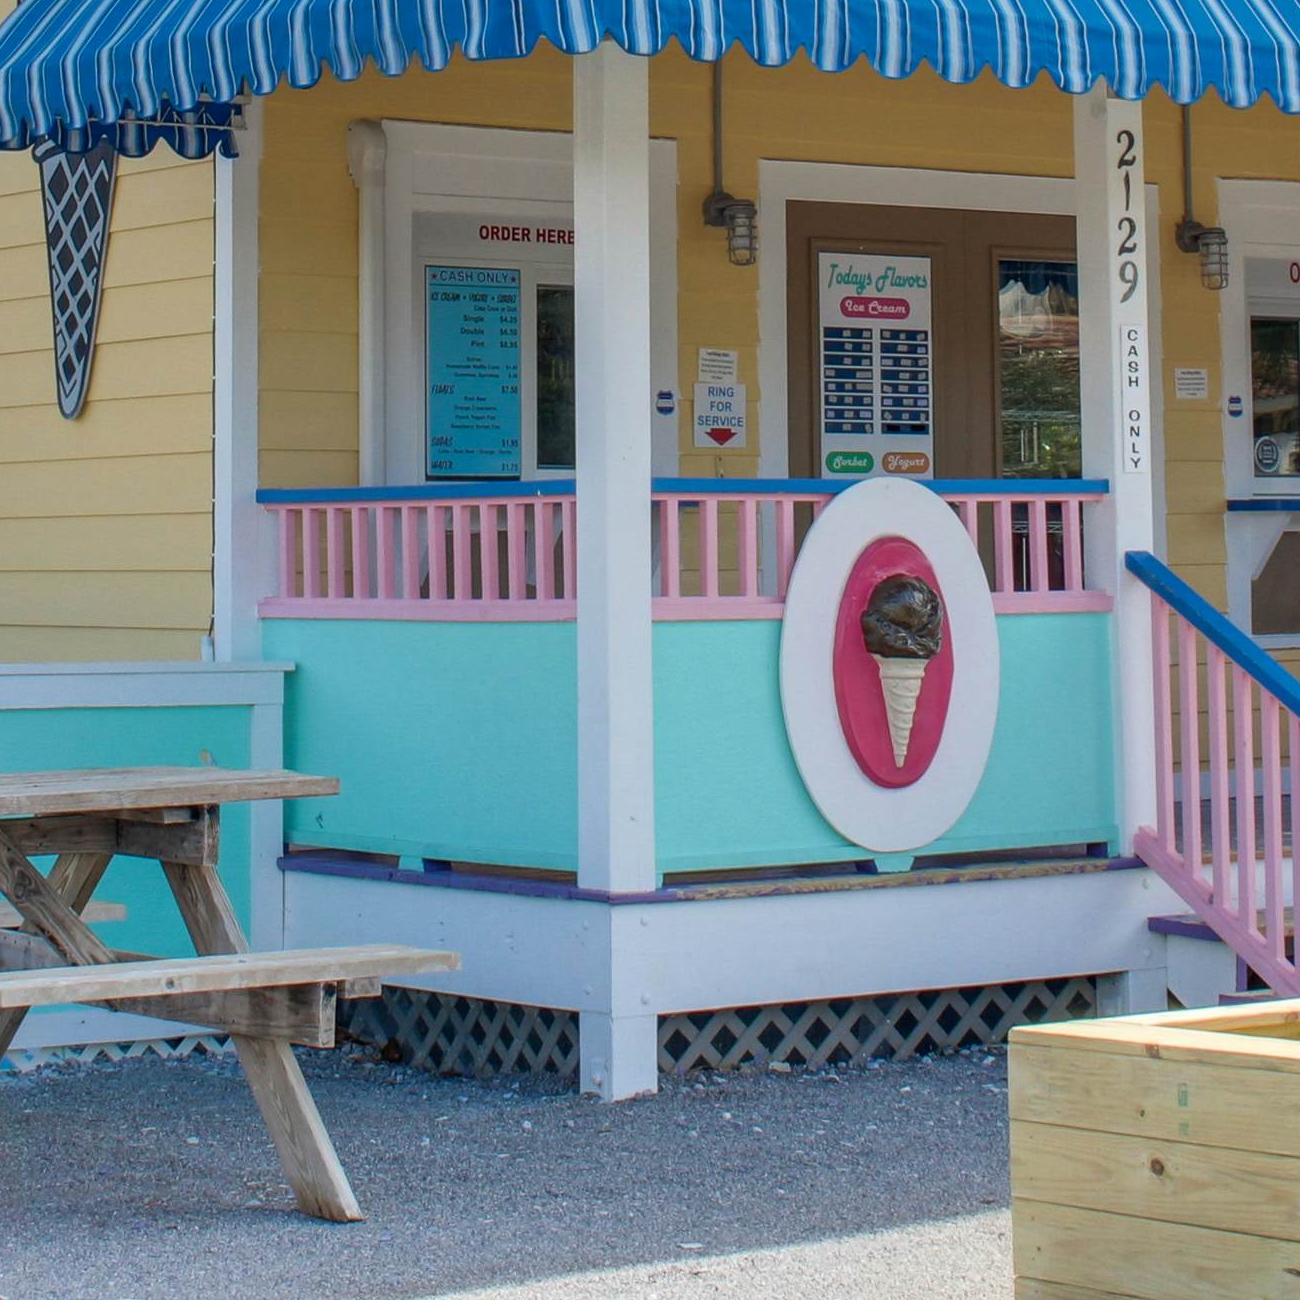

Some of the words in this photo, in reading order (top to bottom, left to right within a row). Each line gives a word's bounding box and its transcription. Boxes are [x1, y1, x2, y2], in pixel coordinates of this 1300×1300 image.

[1116, 129, 1139, 304] 2129
[479, 225, 531, 242] ORDER
[536, 228, 575, 244] HERE
[439, 270, 474, 282] CASH
[477, 272, 508, 283] ONLY
[828, 263, 872, 295] Todays
[875, 266, 928, 293] Flavors
[845, 299, 865, 312] Ice
[868, 301, 906, 314] Cream
[1127, 329, 1139, 387] CASH
[708, 386, 734, 397] RING
[710, 401, 732, 412] FOR
[697, 415, 744, 427] SERVICE
[1129, 410, 1140, 468] ONLY
[888, 455, 926, 470] Yogurt
